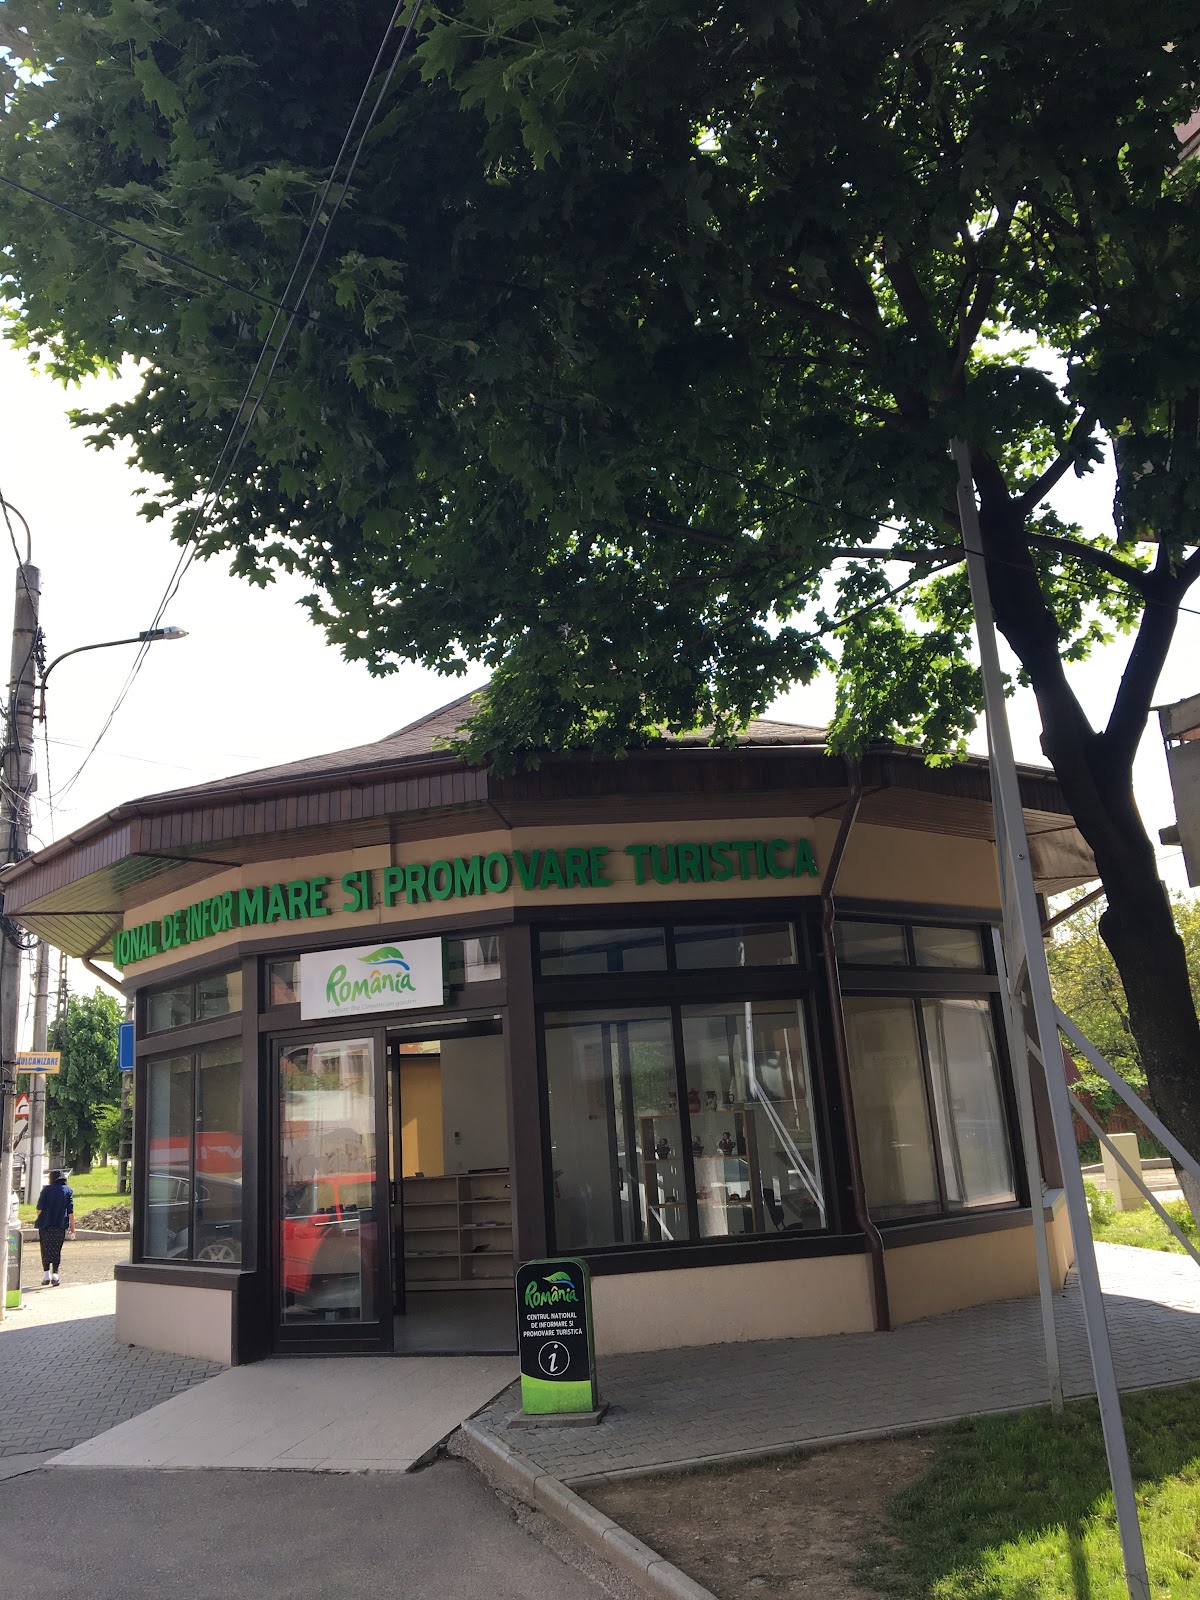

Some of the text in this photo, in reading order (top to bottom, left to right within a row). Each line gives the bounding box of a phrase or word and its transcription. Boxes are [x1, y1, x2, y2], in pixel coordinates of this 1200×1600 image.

[162, 910, 185, 950] DE
[342, 870, 373, 912] SI
[625, 838, 819, 885] TURISTICA
[326, 964, 416, 1007] România
[525, 1281, 579, 1309] România
[526, 1313, 550, 1321] CENTRUL
[523, 1329, 555, 1338] PROMOVARE
